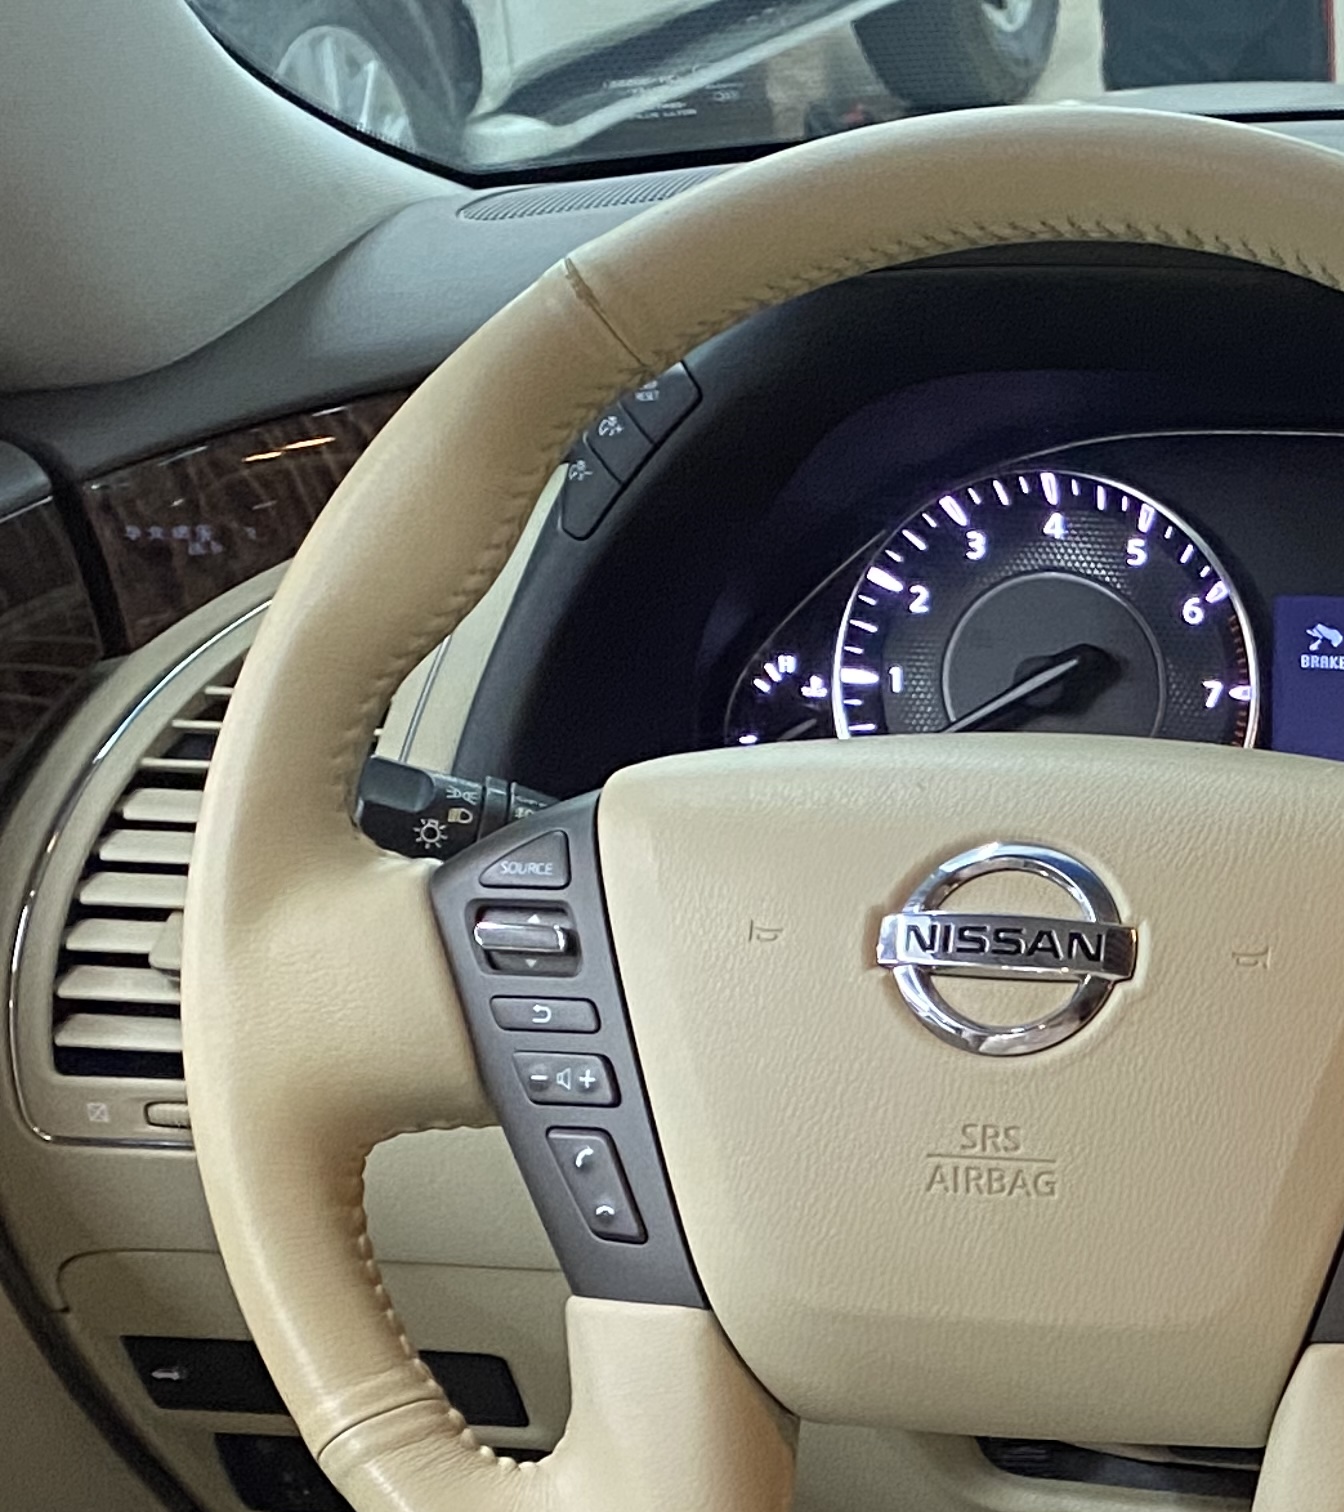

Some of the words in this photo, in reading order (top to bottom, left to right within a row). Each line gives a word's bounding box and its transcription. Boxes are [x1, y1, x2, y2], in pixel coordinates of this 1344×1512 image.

[1041, 512, 1065, 538] 4
[966, 531, 986, 559] 3
[1126, 538, 1147, 567] 5
[909, 584, 929, 613] 2
[1182, 595, 1203, 624] 6
[888, 665, 903, 692] 1
[1202, 680, 1223, 707] 7
[500, 860, 554, 876] SOURCE
[904, 924, 1106, 962] NISSAN
[960, 1123, 1021, 1153] SRS
[925, 1165, 1057, 1198] AIRBAG
